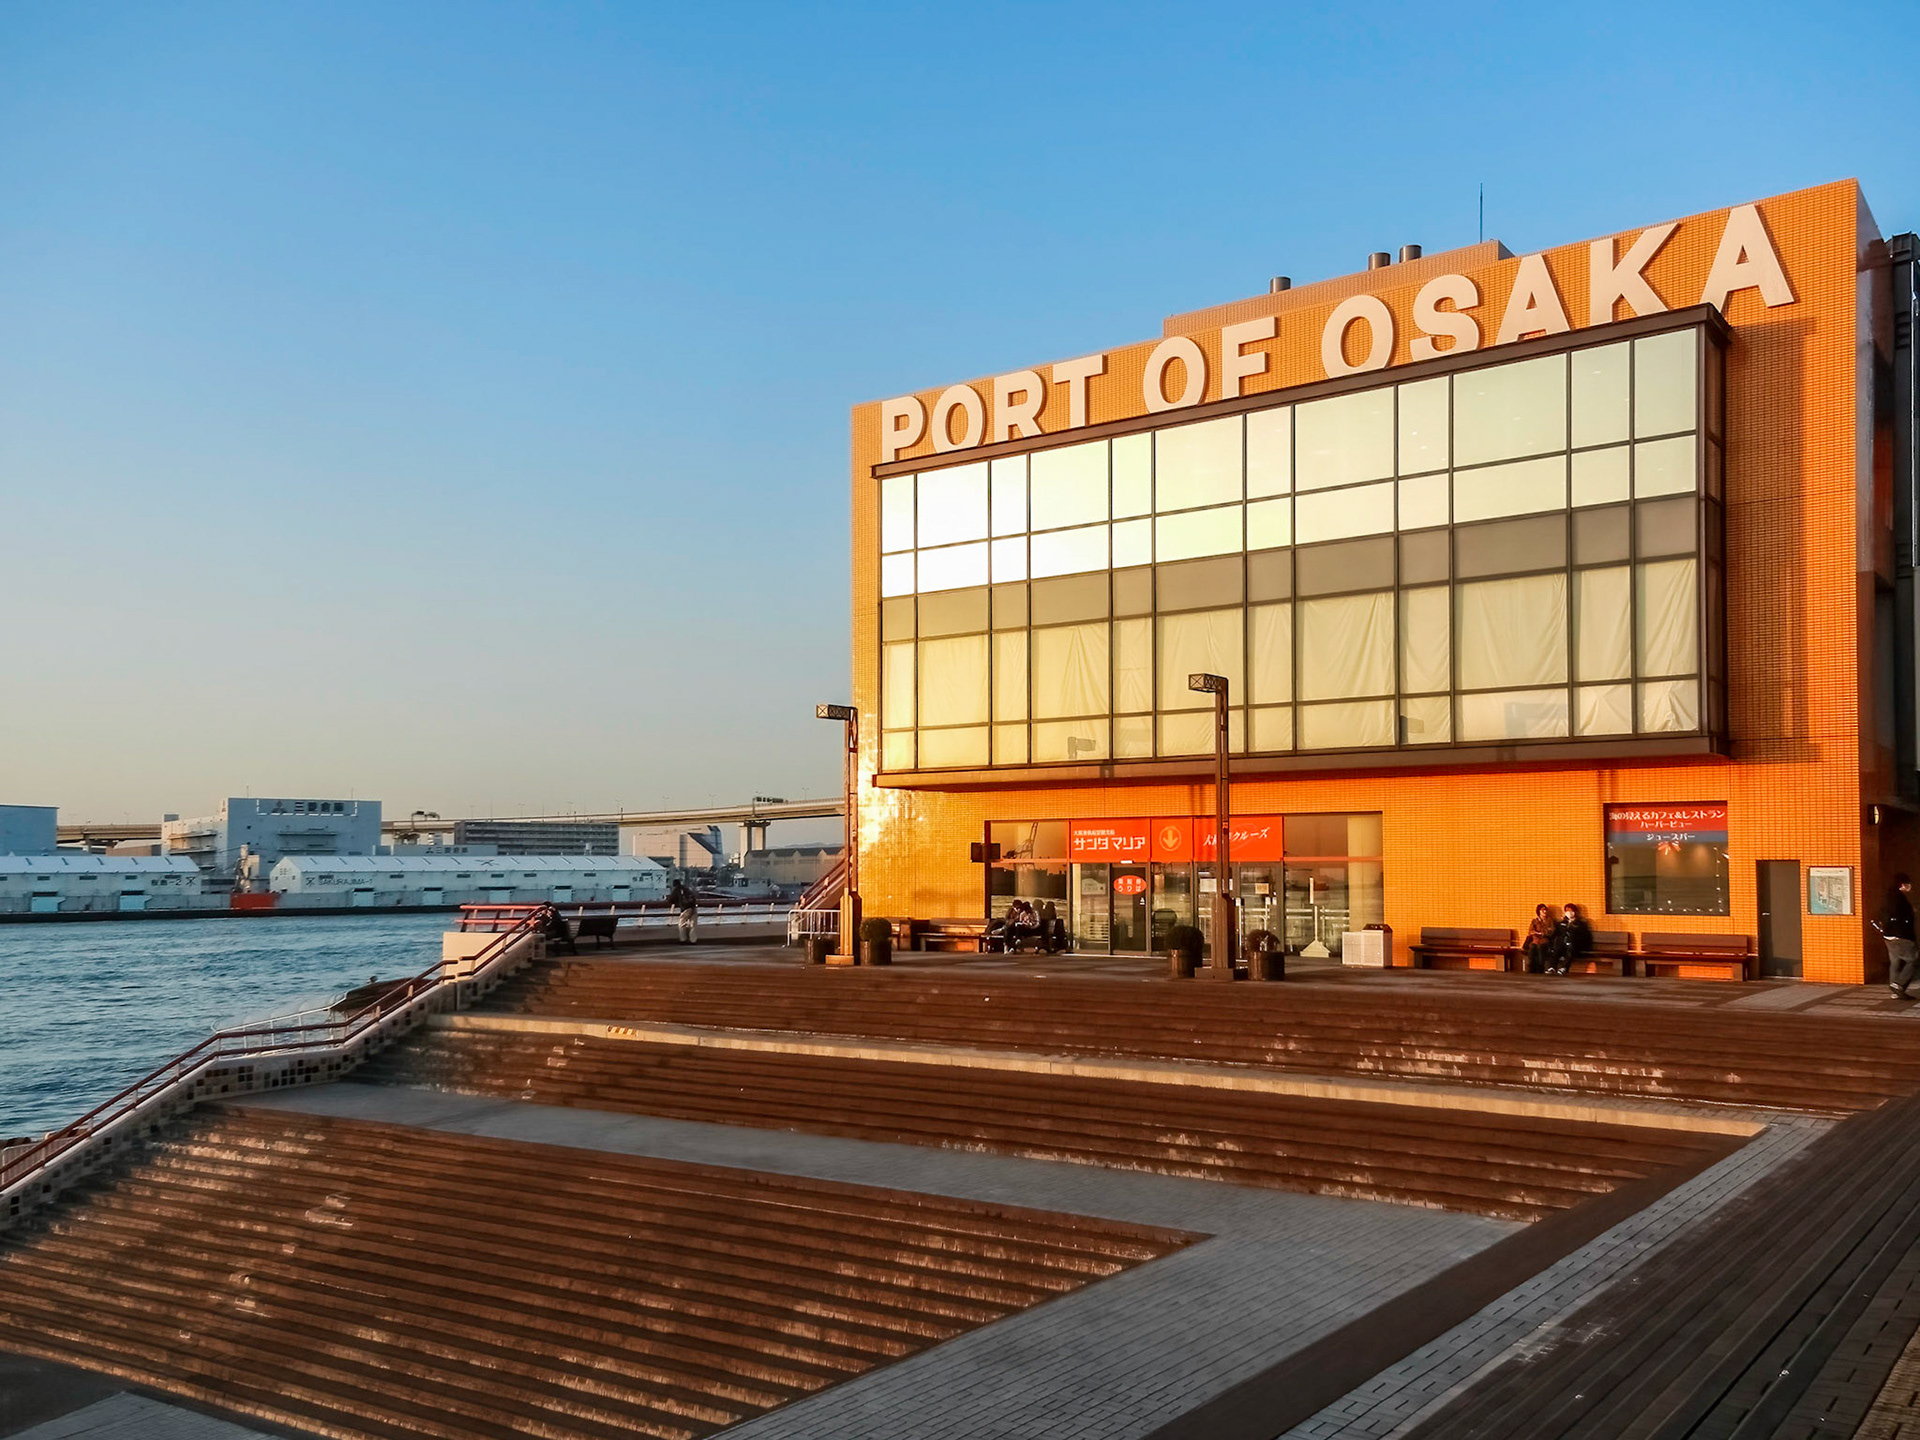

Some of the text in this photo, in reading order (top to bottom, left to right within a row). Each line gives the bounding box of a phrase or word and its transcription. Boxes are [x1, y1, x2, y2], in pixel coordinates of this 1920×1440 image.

[881, 204, 1795, 463] PORT OF OSAKA
[1203, 827, 1271, 849] 大クルーズ
